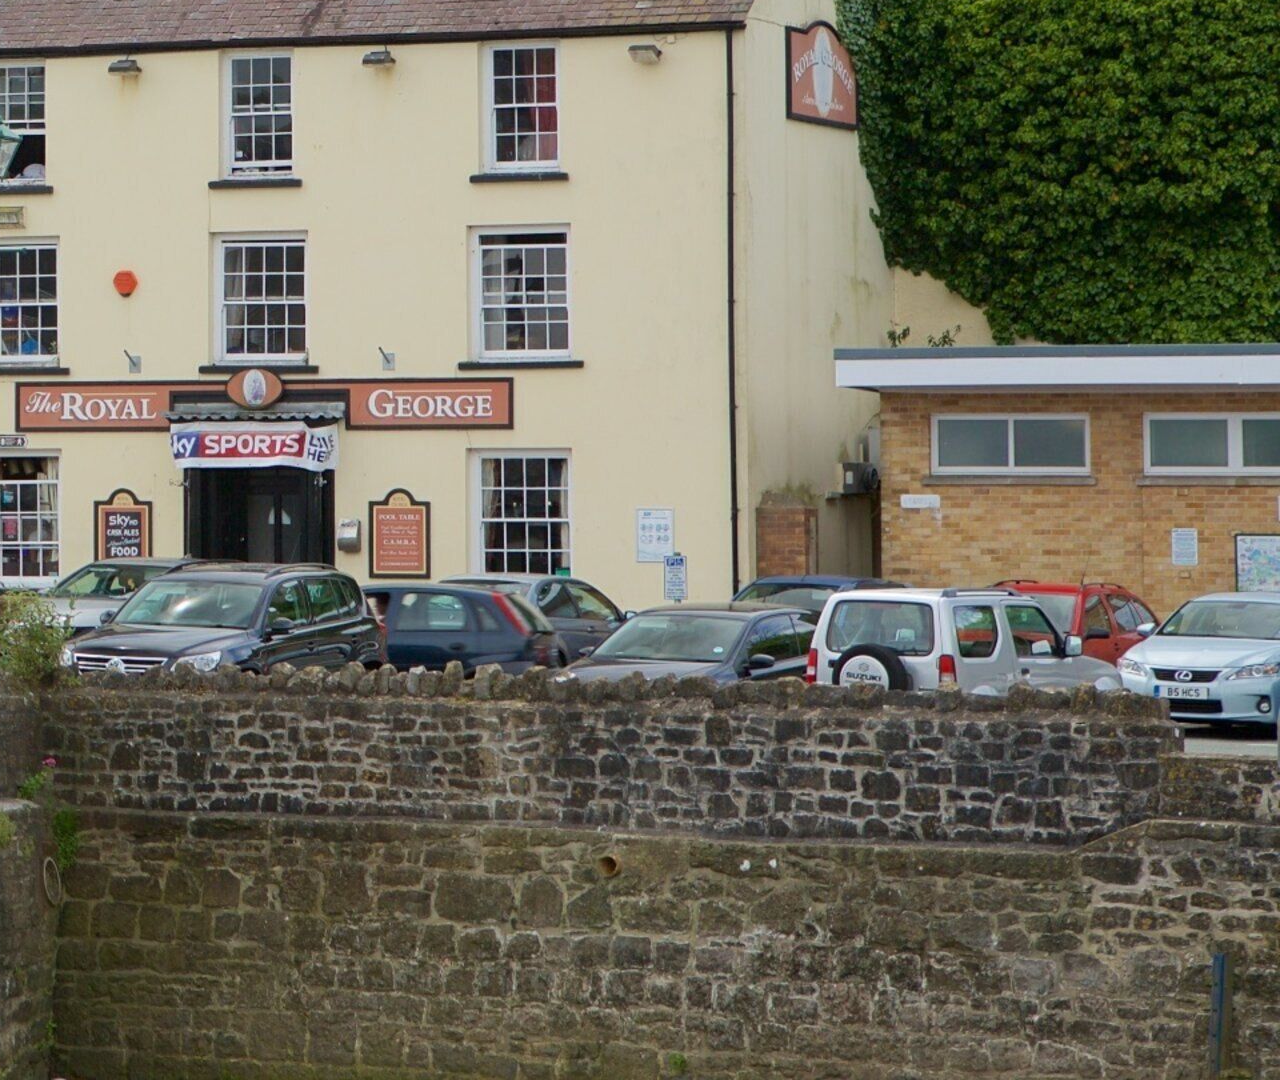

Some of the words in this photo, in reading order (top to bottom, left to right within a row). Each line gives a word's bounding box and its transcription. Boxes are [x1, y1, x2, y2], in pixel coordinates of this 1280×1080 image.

[25, 391, 60, 413] The
[61, 392, 157, 420] ROYAL
[368, 389, 493, 418] GEORGE
[171, 433, 195, 457] ky
[204, 434, 300, 455] SPORTS
[379, 513, 397, 521] POOL
[399, 513, 420, 521] TABLE
[123, 528, 140, 537] ALES
[111, 546, 139, 557] FOOD
[846, 671, 882, 682] SUZUKI
